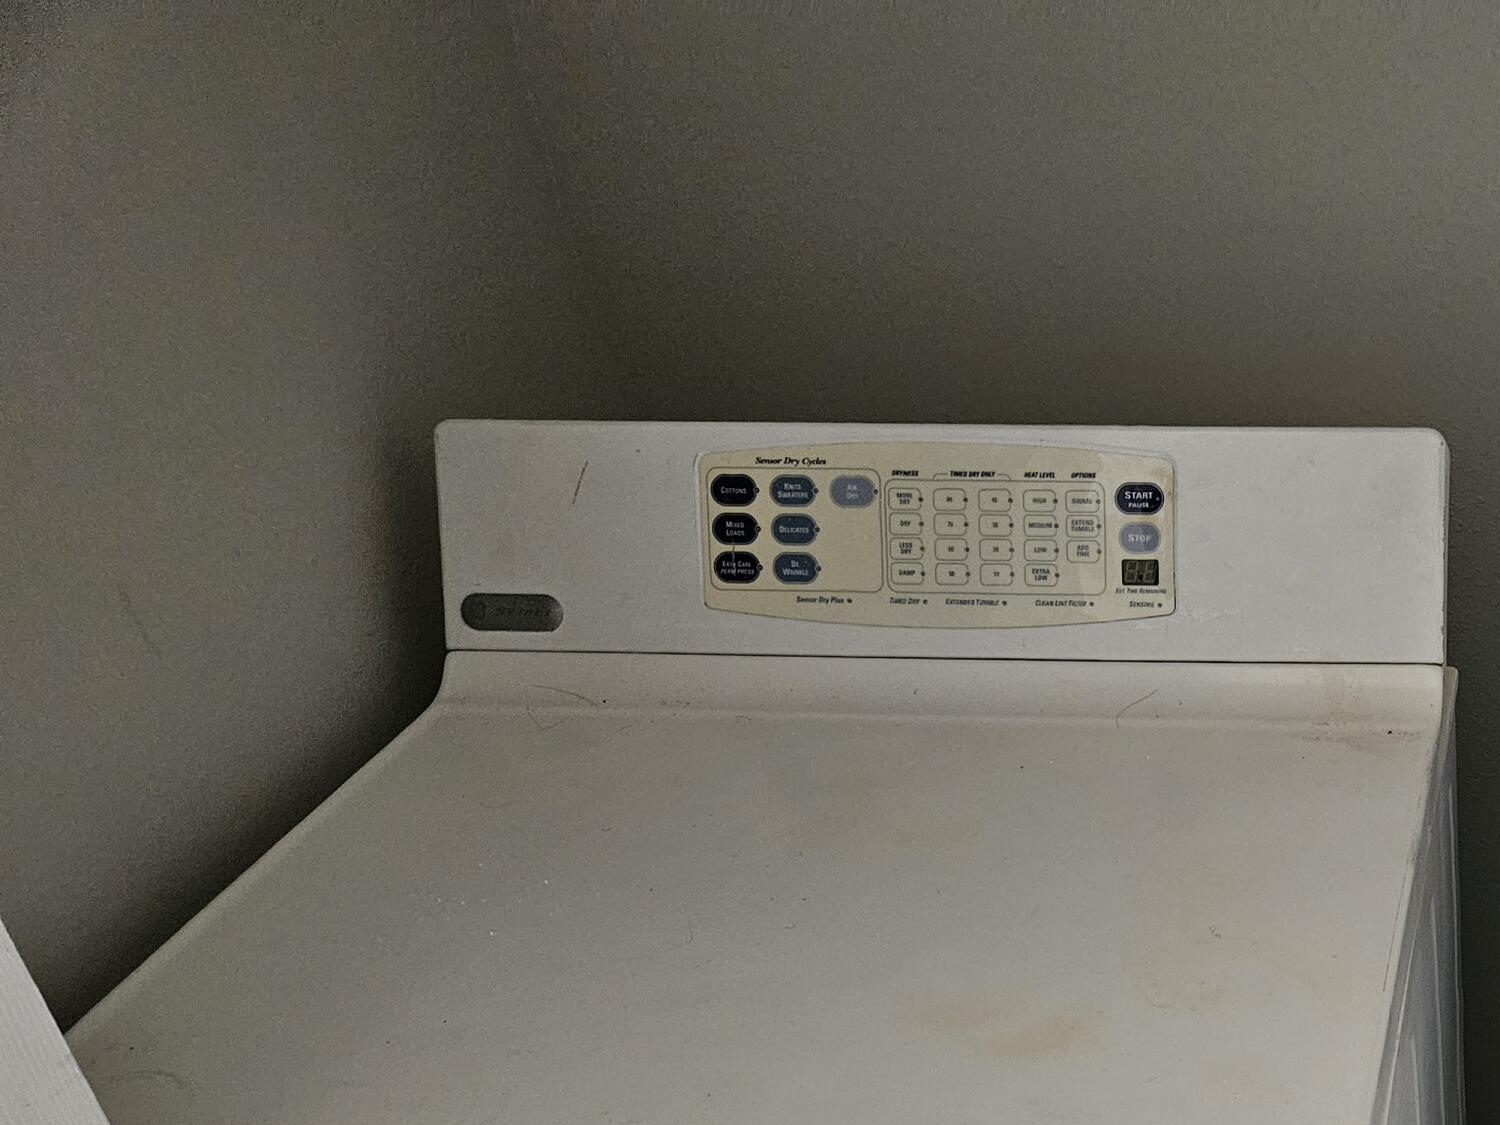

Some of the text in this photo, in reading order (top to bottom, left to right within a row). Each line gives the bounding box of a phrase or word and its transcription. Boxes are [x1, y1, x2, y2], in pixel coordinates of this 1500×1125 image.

[755, 457, 826, 467] Sensor Dry Cycles
[1125, 490, 1152, 500] START
[1128, 534, 1151, 542] STOP
